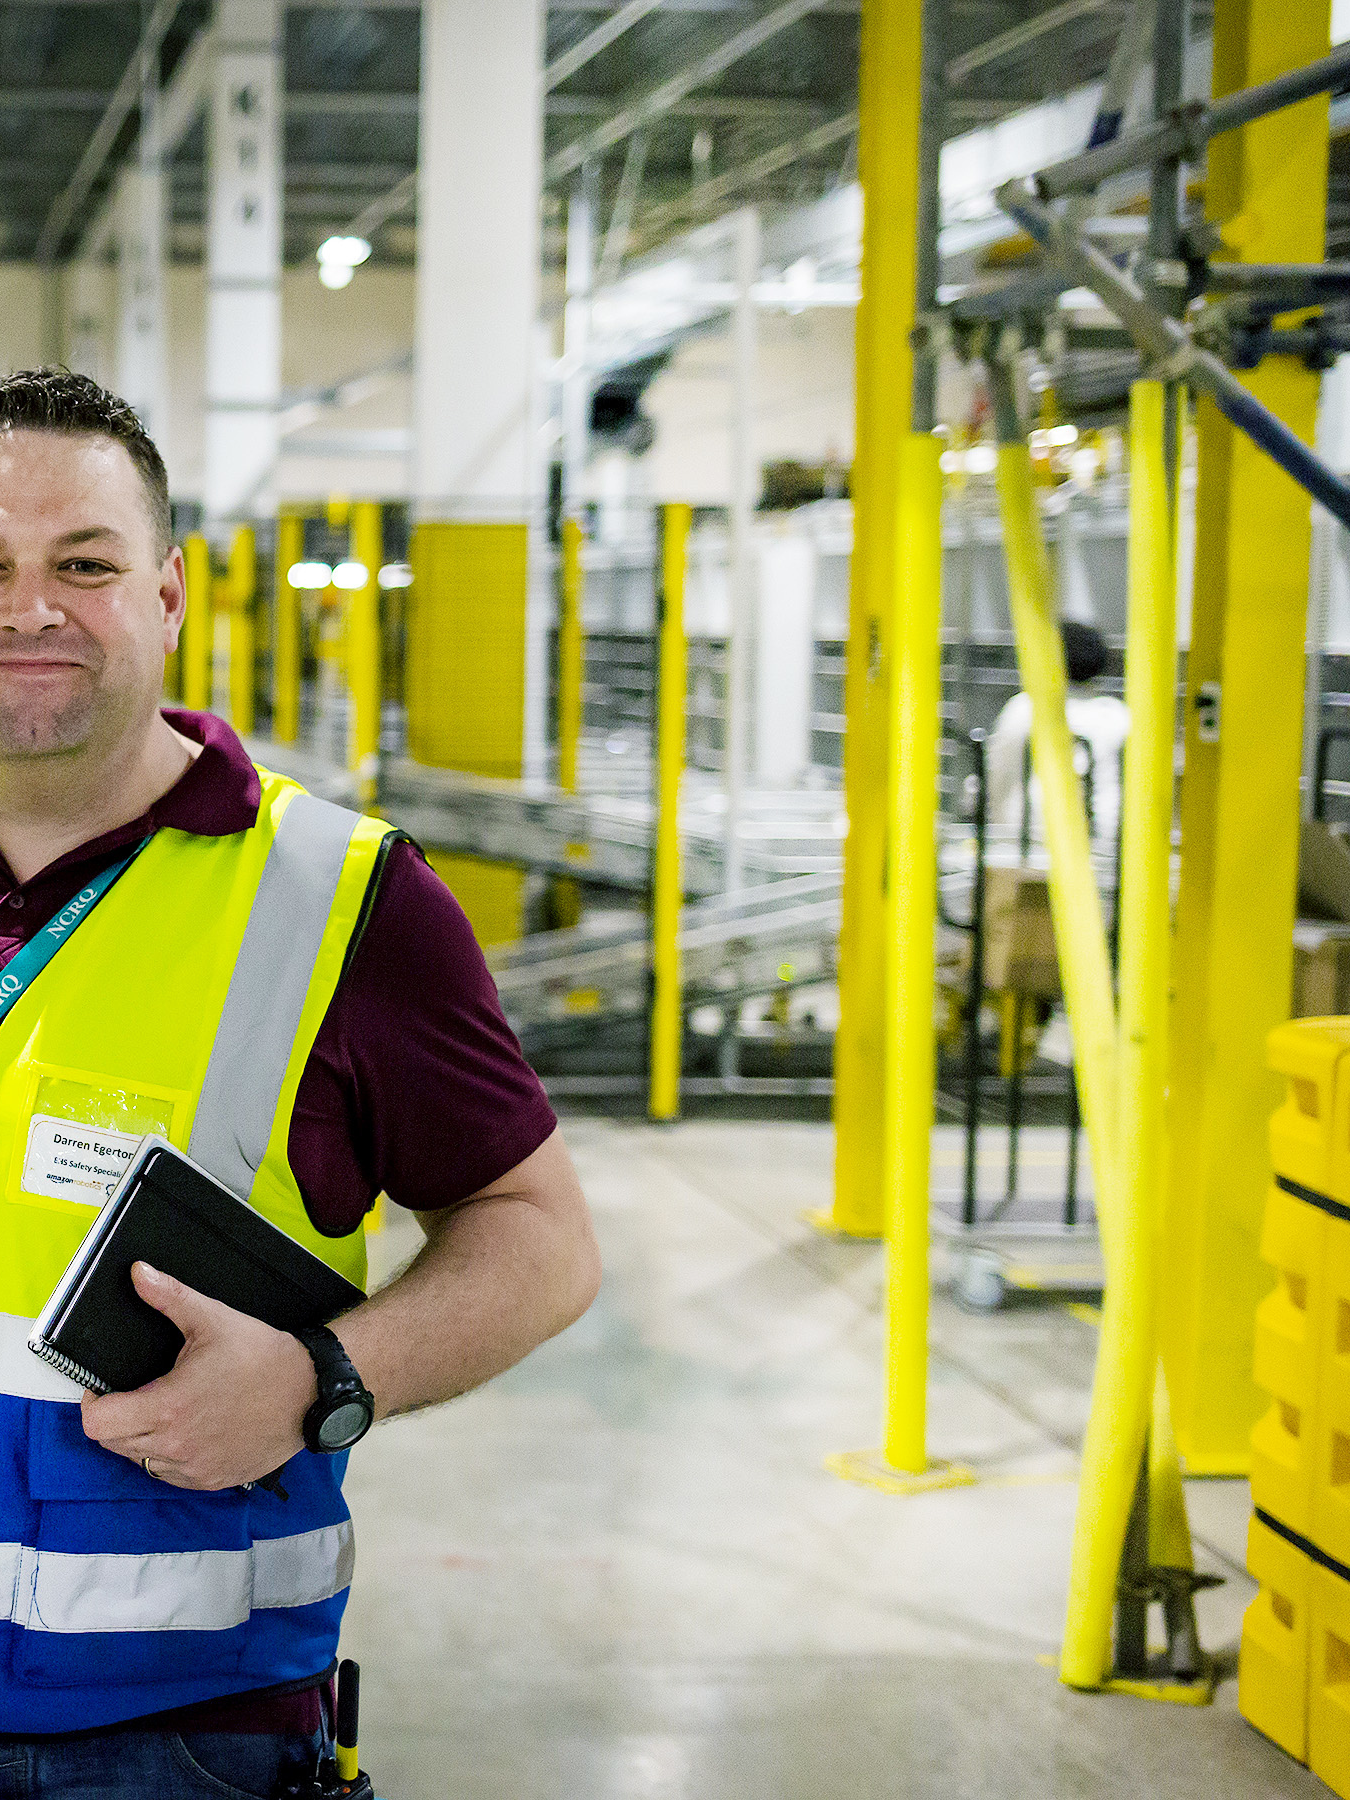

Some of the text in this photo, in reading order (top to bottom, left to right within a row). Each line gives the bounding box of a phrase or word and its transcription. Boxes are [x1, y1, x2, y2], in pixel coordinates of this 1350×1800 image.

[46, 888, 98, 940] NCRQ
[53, 1133, 90, 1151] Darren
[68, 1160, 93, 1173] Safety
[93, 1165, 123, 1178] Speciali
